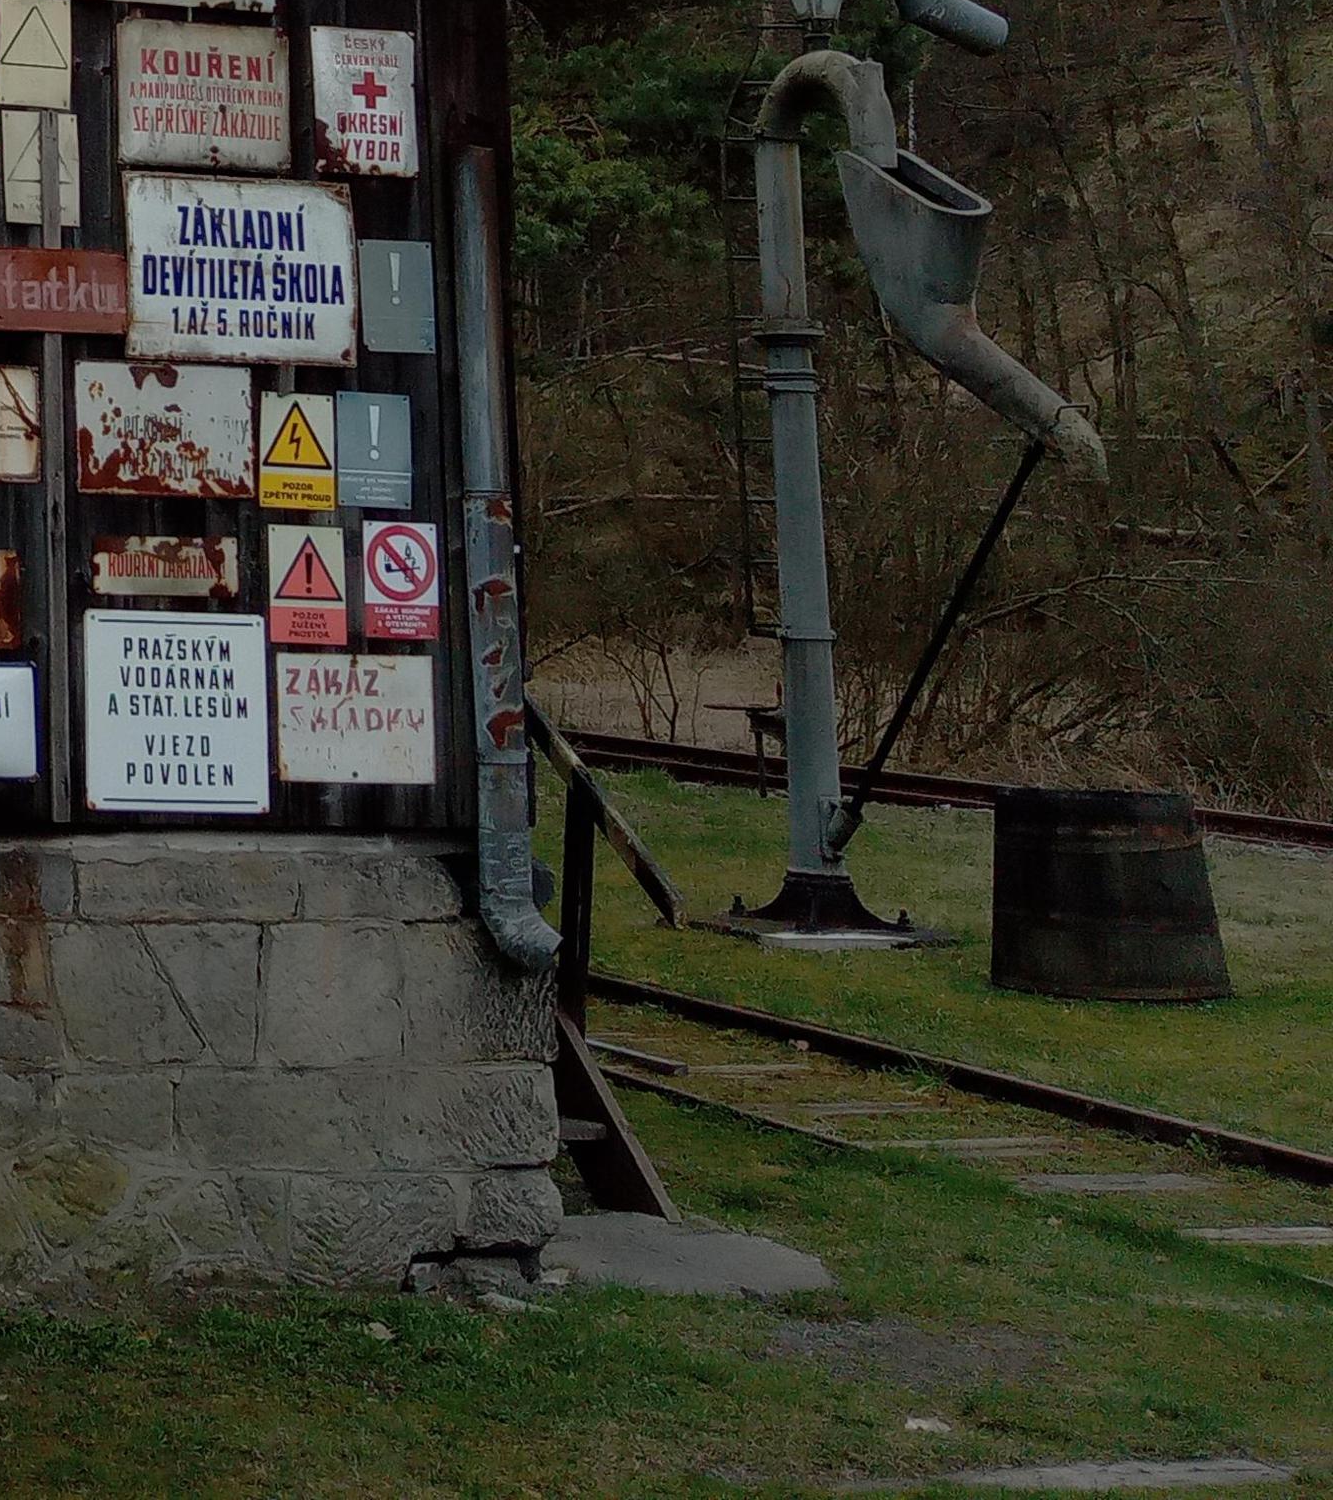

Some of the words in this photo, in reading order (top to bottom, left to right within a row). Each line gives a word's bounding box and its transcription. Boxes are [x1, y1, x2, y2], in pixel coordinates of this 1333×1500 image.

[345, 35, 388, 49] ČESKÝ
[140, 46, 276, 83] KOUŘENÍ
[337, 111, 403, 136] OKRESNÍ
[179, 197, 306, 251] ZÁKLADNÍ
[143, 247, 264, 301] DEVÍTILETÁ
[272, 255, 345, 306] ŠKOLA
[122, 634, 230, 662] PRAŽSKÝM
[120, 660, 235, 690] VODÁRNÁM
[107, 693, 119, 714] A
[128, 695, 179, 717] STAT.
[183, 689, 248, 719] LESŮM
[144, 734, 211, 757] VJEZD
[125, 762, 234, 786] POVOLEN
